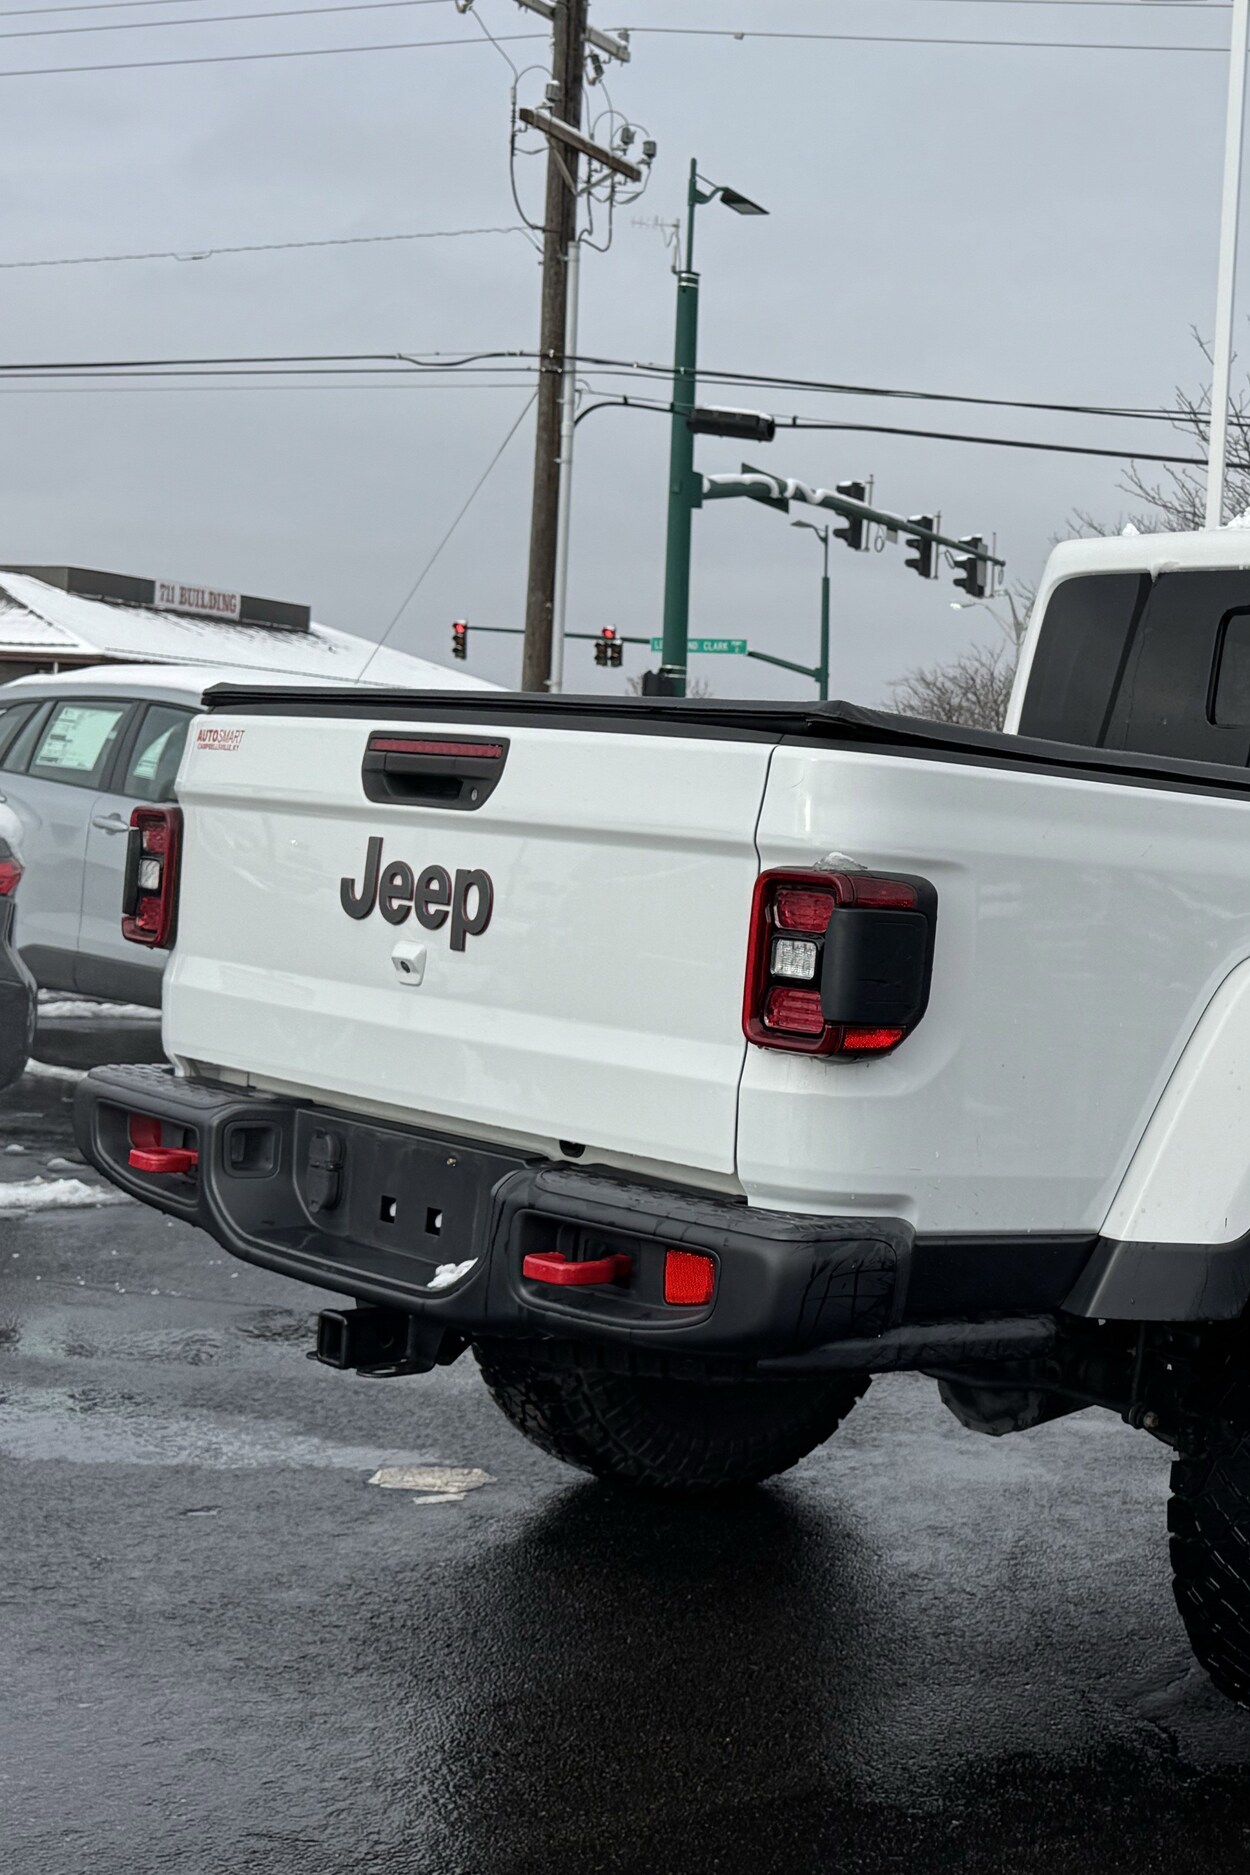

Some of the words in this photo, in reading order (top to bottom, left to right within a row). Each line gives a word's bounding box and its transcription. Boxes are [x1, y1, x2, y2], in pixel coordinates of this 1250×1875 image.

[160, 584, 174, 603] 711
[180, 586, 237, 613] BUILDING
[703, 641, 728, 651] CLARK
[340, 836, 494, 952] Jeep
